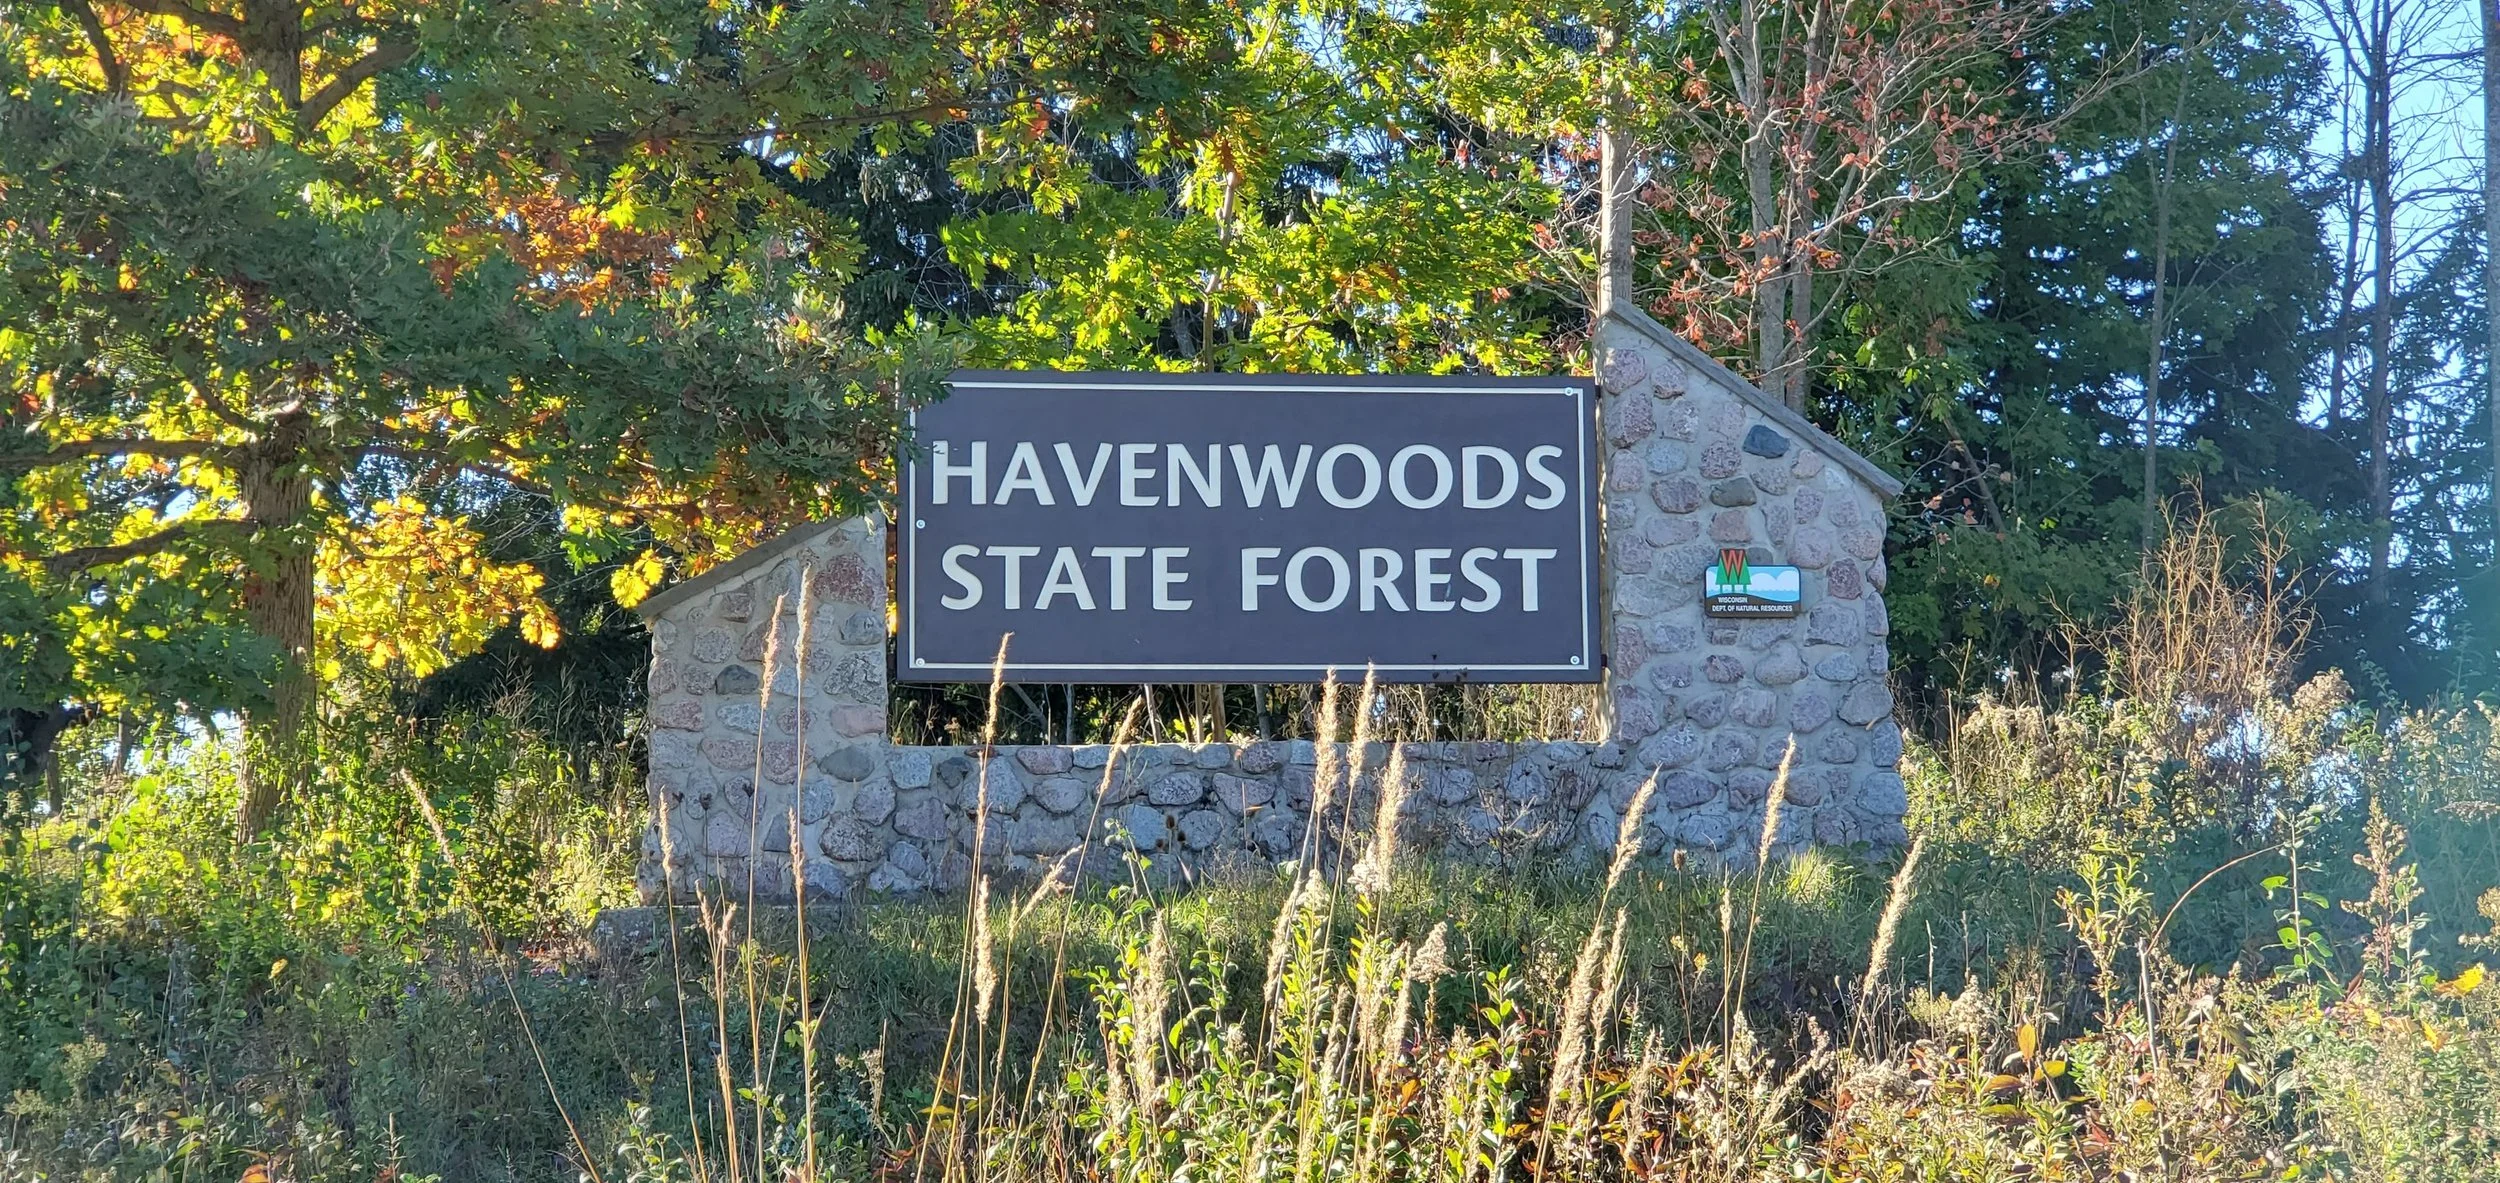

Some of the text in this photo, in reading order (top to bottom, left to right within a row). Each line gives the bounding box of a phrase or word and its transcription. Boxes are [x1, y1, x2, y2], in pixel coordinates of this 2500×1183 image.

[931, 440, 1567, 510] HAVENWOODS
[940, 543, 1558, 614] STATE FOREST
